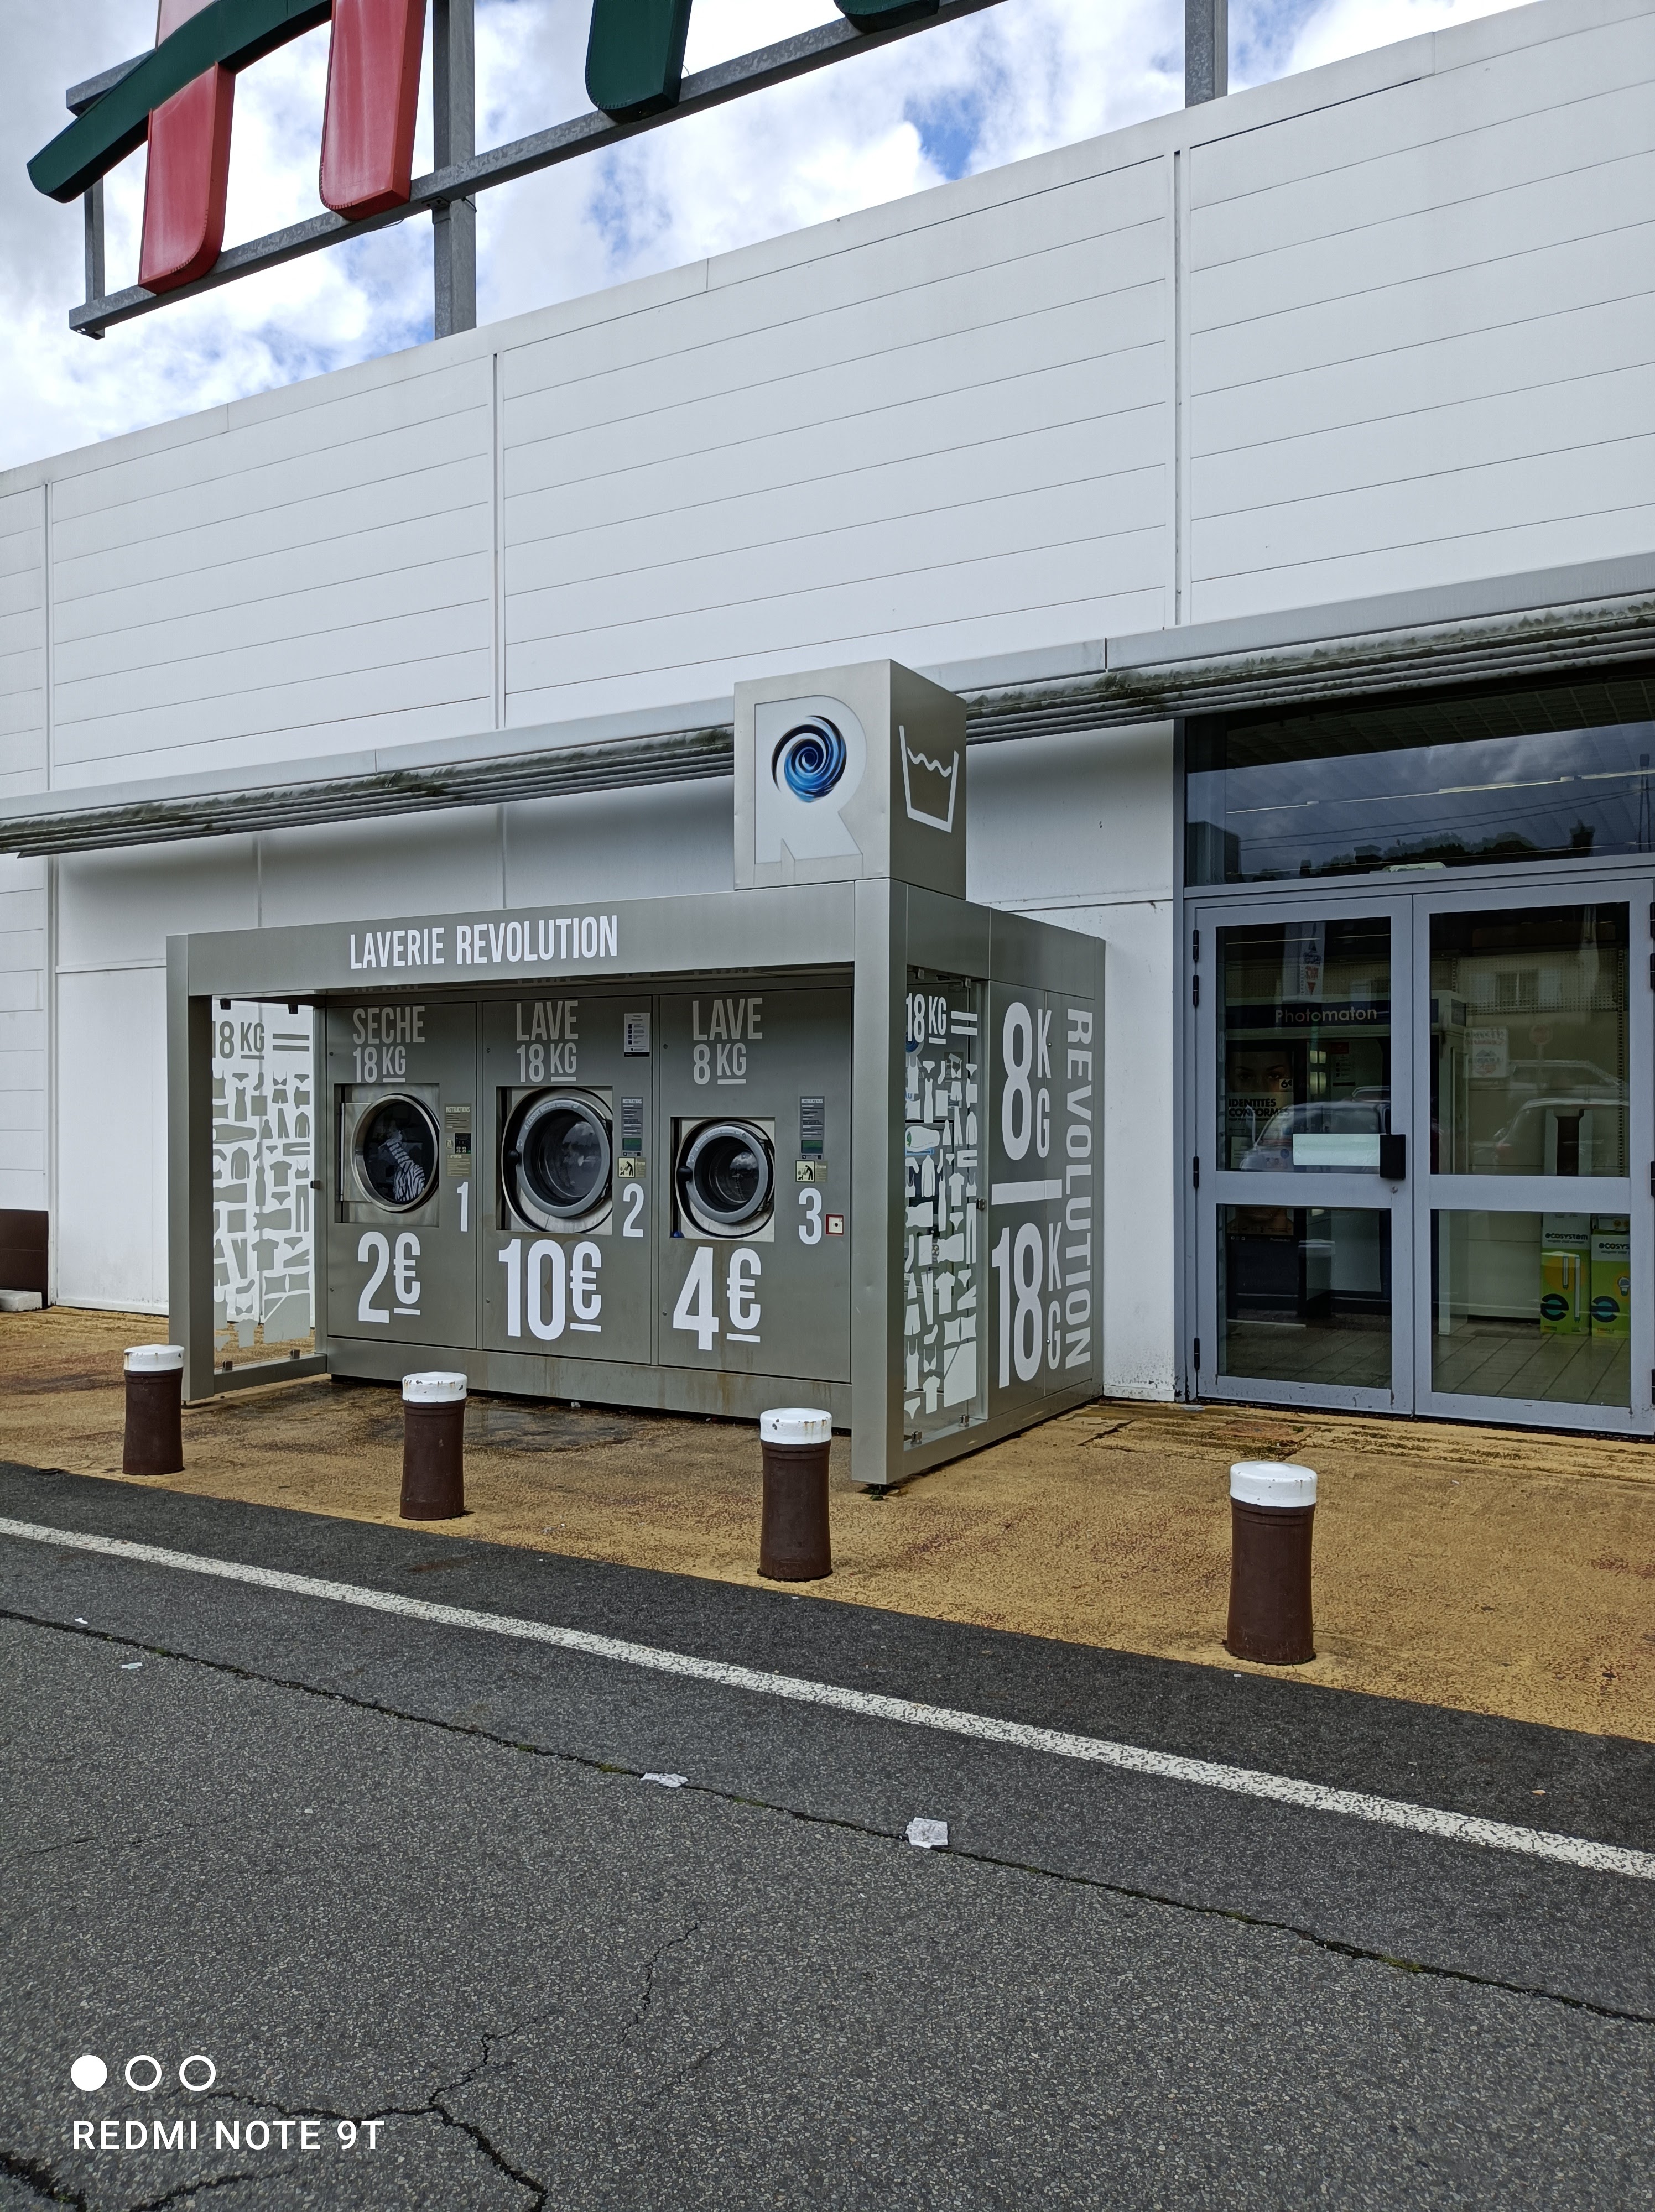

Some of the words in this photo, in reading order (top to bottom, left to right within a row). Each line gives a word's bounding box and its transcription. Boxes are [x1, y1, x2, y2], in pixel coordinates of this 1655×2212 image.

[350, 927, 445, 969] LAVERIE
[457, 915, 617, 965] REVOLUTION
[240, 1022, 265, 1052] KG
[353, 1006, 425, 1045] SECHE
[516, 1000, 579, 1041] LAVE
[693, 998, 763, 1041] LAVE
[905, 993, 925, 1043] 18
[929, 995, 946, 1035] KG
[1276, 1006, 1377, 1023] Photomaton
[353, 1047, 377, 1083] 18
[383, 1046, 406, 1076] KG
[517, 1044, 544, 1083] 18
[550, 1042, 576, 1074] KG
[693, 1044, 710, 1085] 8
[717, 1043, 746, 1076] KG
[1002, 1001, 1033, 1161] 8
[1281, 1079, 1293, 1088] 6€
[457, 1181, 469, 1232] 1
[623, 1183, 644, 1238] 2
[1065, 1008, 1093, 1369] REVOLUTION
[798, 1187, 822, 1245] 3
[358, 1231, 421, 1324] 2€
[498, 1238, 602, 1340] 10€
[673, 1246, 761, 1350] 4€
[992, 1222, 1043, 1389] 18
